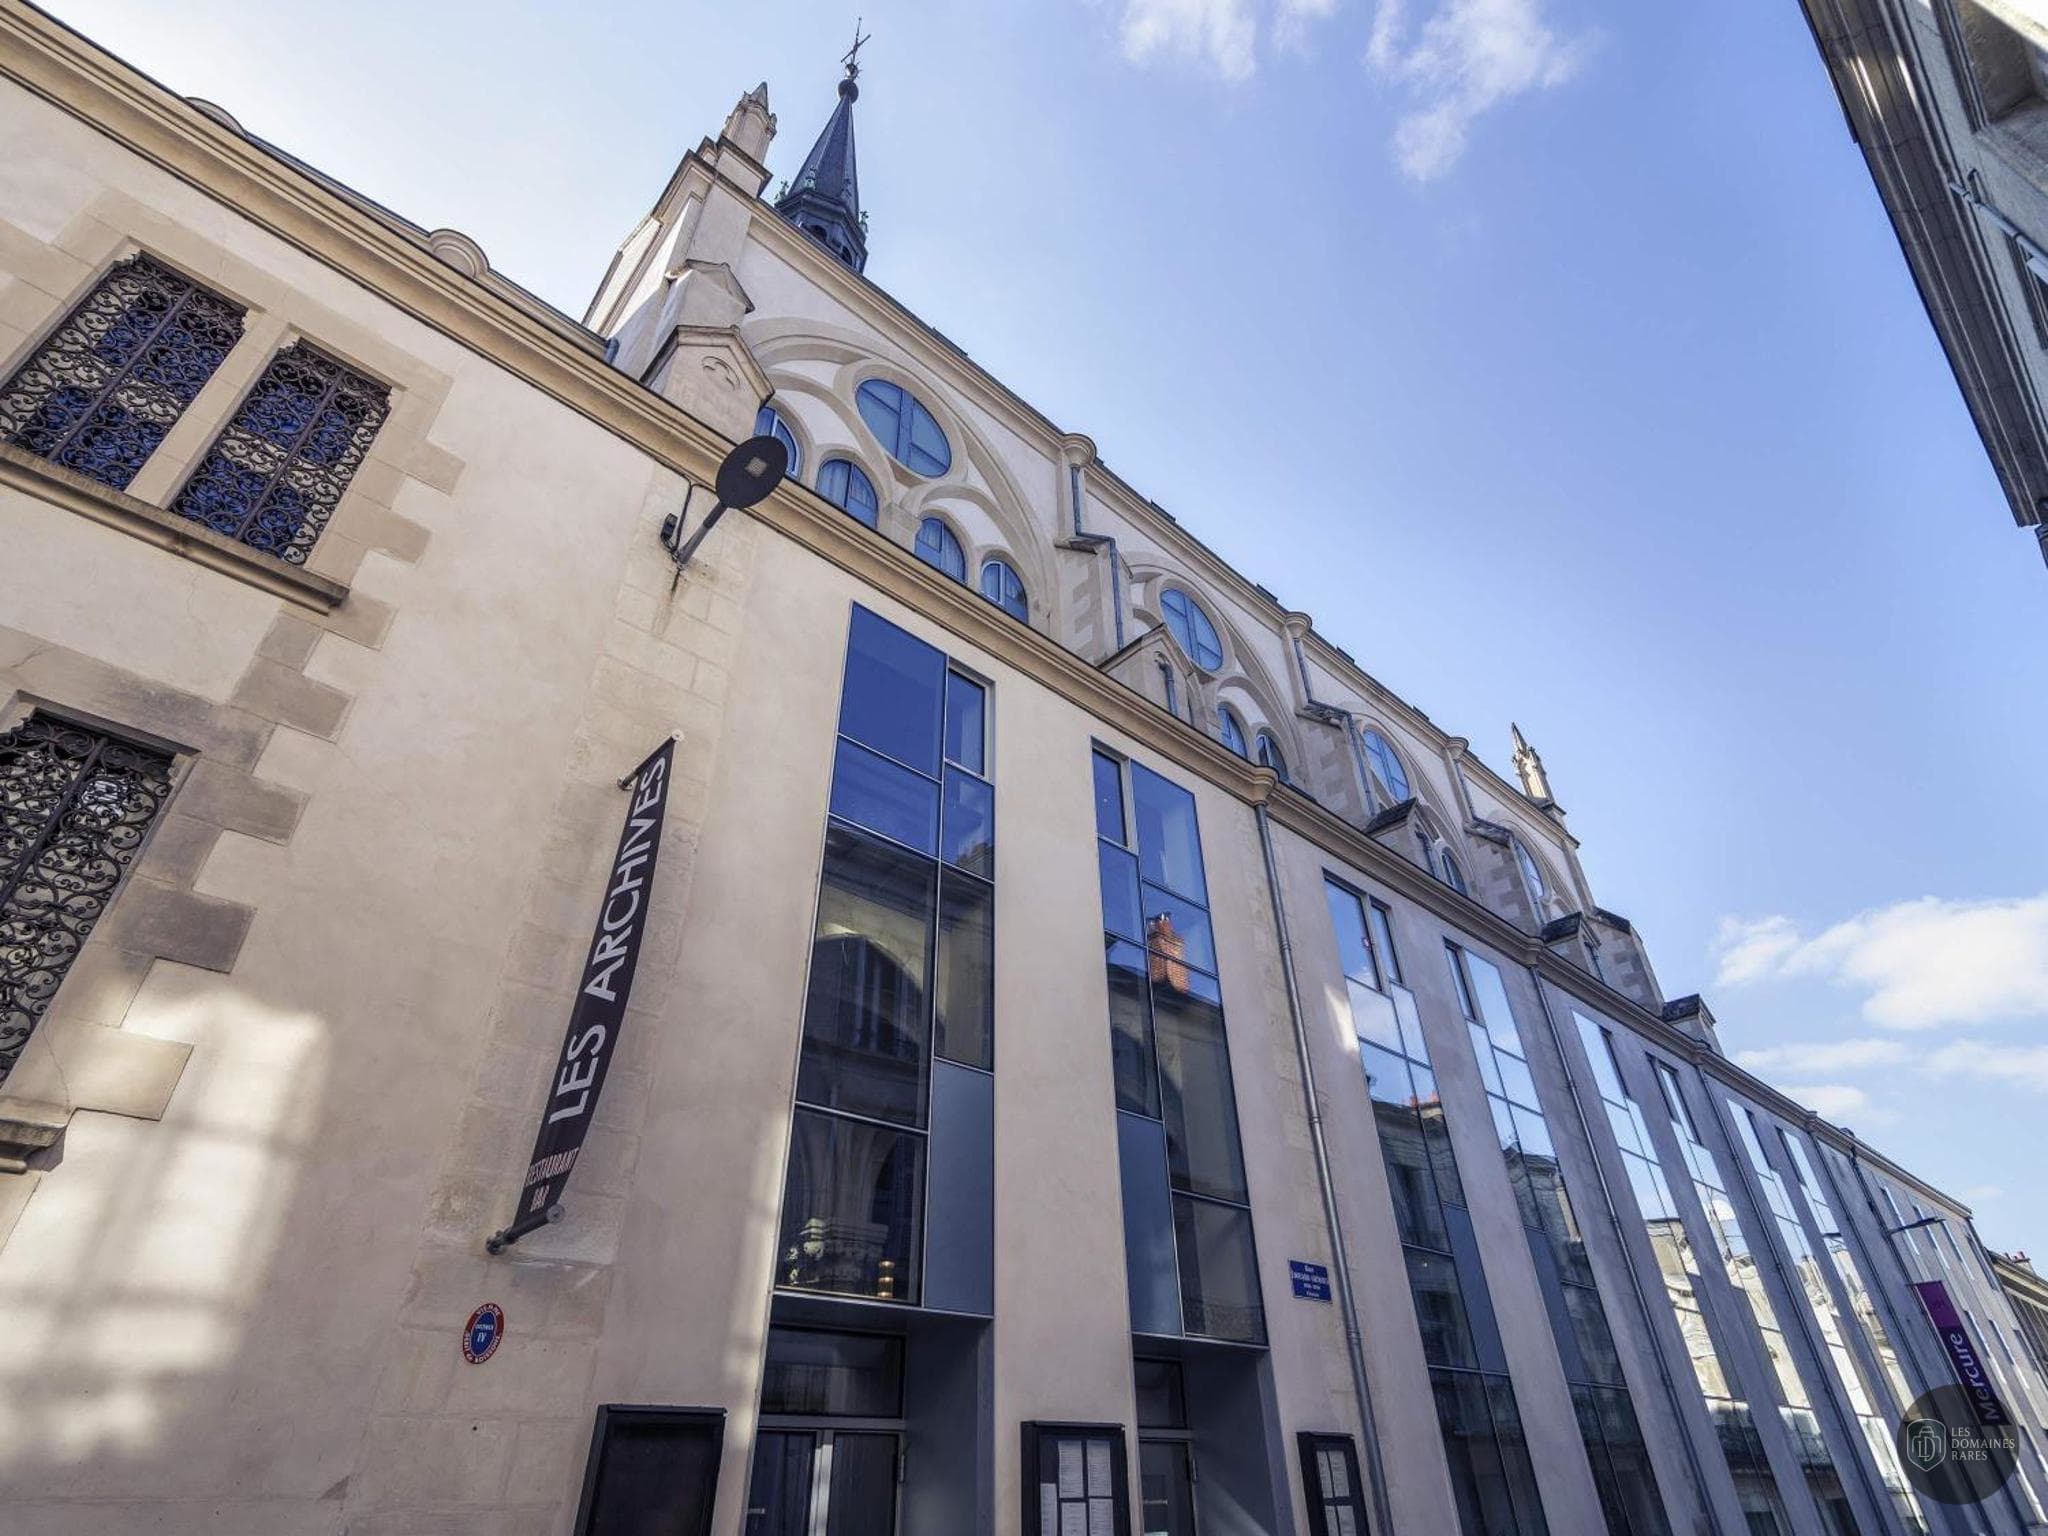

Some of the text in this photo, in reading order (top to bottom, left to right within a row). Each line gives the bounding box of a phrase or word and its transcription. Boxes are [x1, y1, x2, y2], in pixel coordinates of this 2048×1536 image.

[549, 756, 667, 1126] LES ARCHIVES
[1950, 1332, 2001, 1420] Mercure
